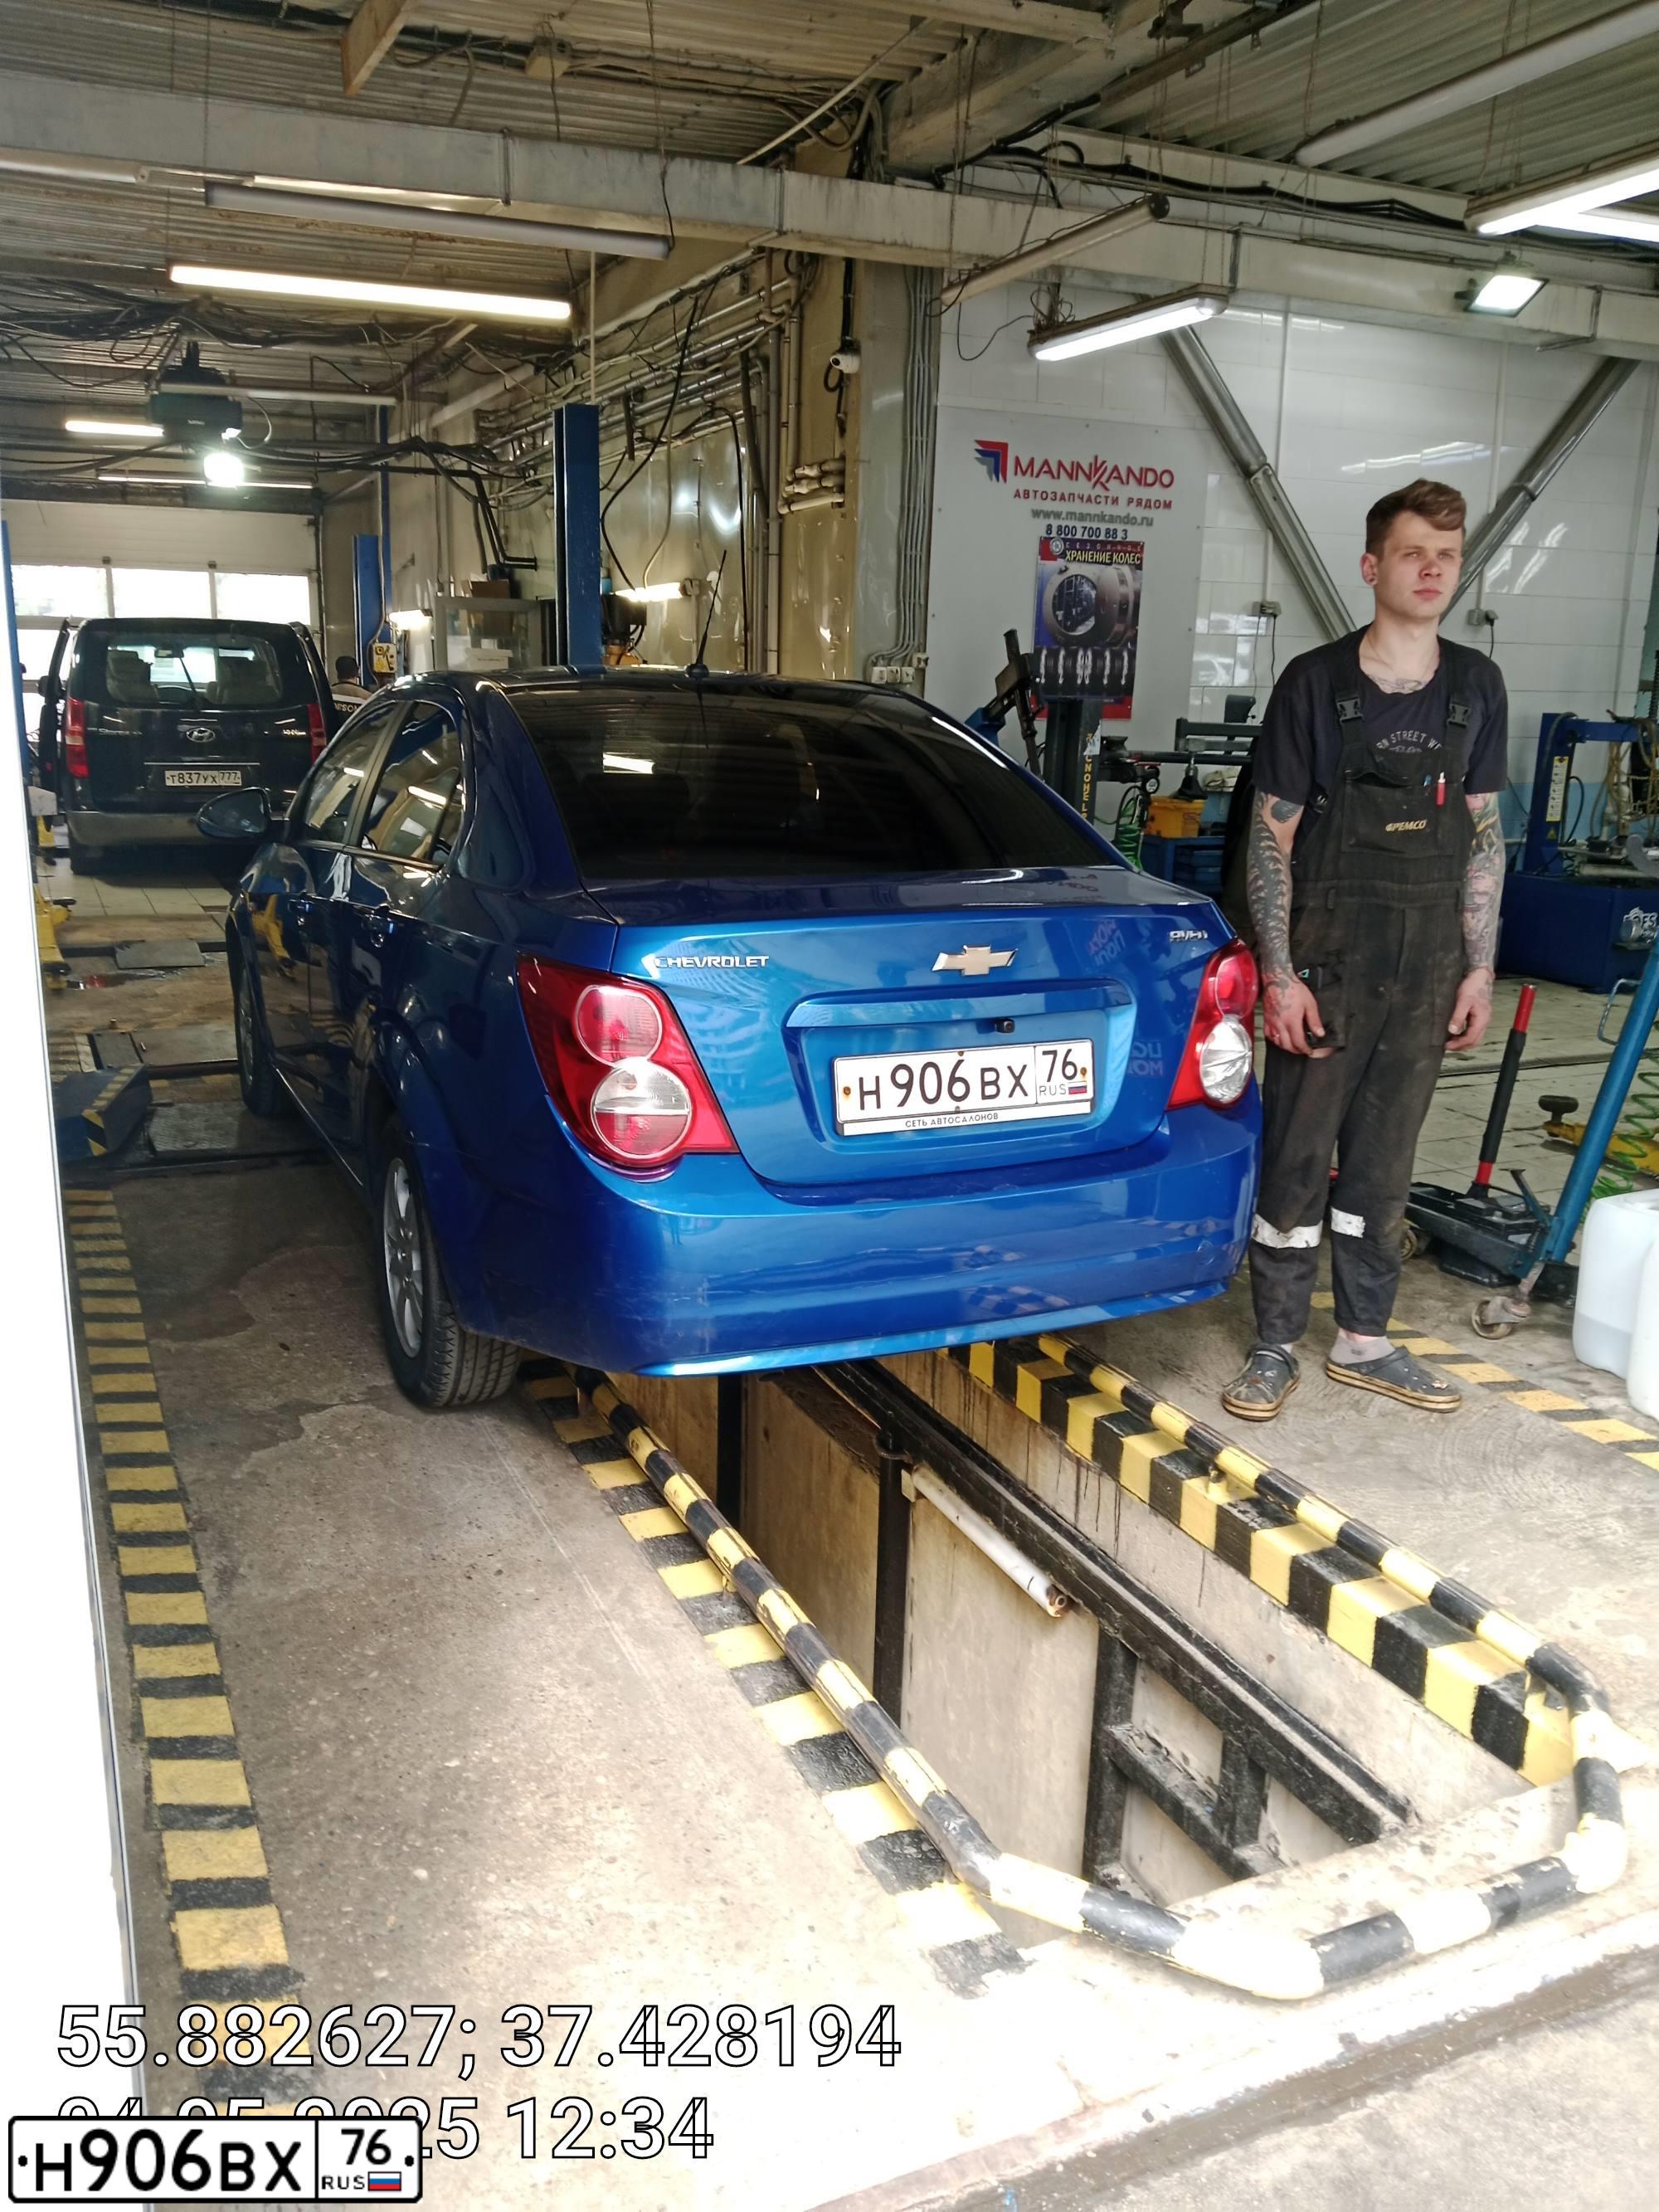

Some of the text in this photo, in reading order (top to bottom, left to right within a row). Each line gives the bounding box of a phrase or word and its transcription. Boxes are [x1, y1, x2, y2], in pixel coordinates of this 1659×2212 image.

[1014, 455, 1175, 491] MANNKANDO
[1014, 489, 1172, 510] АВТОЗАПЧАСТИ РЯДОМ
[1031, 507, 1154, 527] www.mannkando.ru
[1046, 524, 1053, 536] 8
[1056, 524, 1078, 538] 800
[1081, 525, 1102, 539] 700
[1104, 527, 1118, 540] 88
[1065, 550, 1141, 564] ХРАНЕНИЕ КОЛЕС
[1389, 730, 1428, 743] STREET
[654, 955, 770, 969] CHEVROLET
[1042, 1048, 1078, 1084] 76
[1039, 1084, 1068, 1097] RUS
[905, 1112, 1000, 1128] СЕТЬ АВТОСАЛОНОВ
